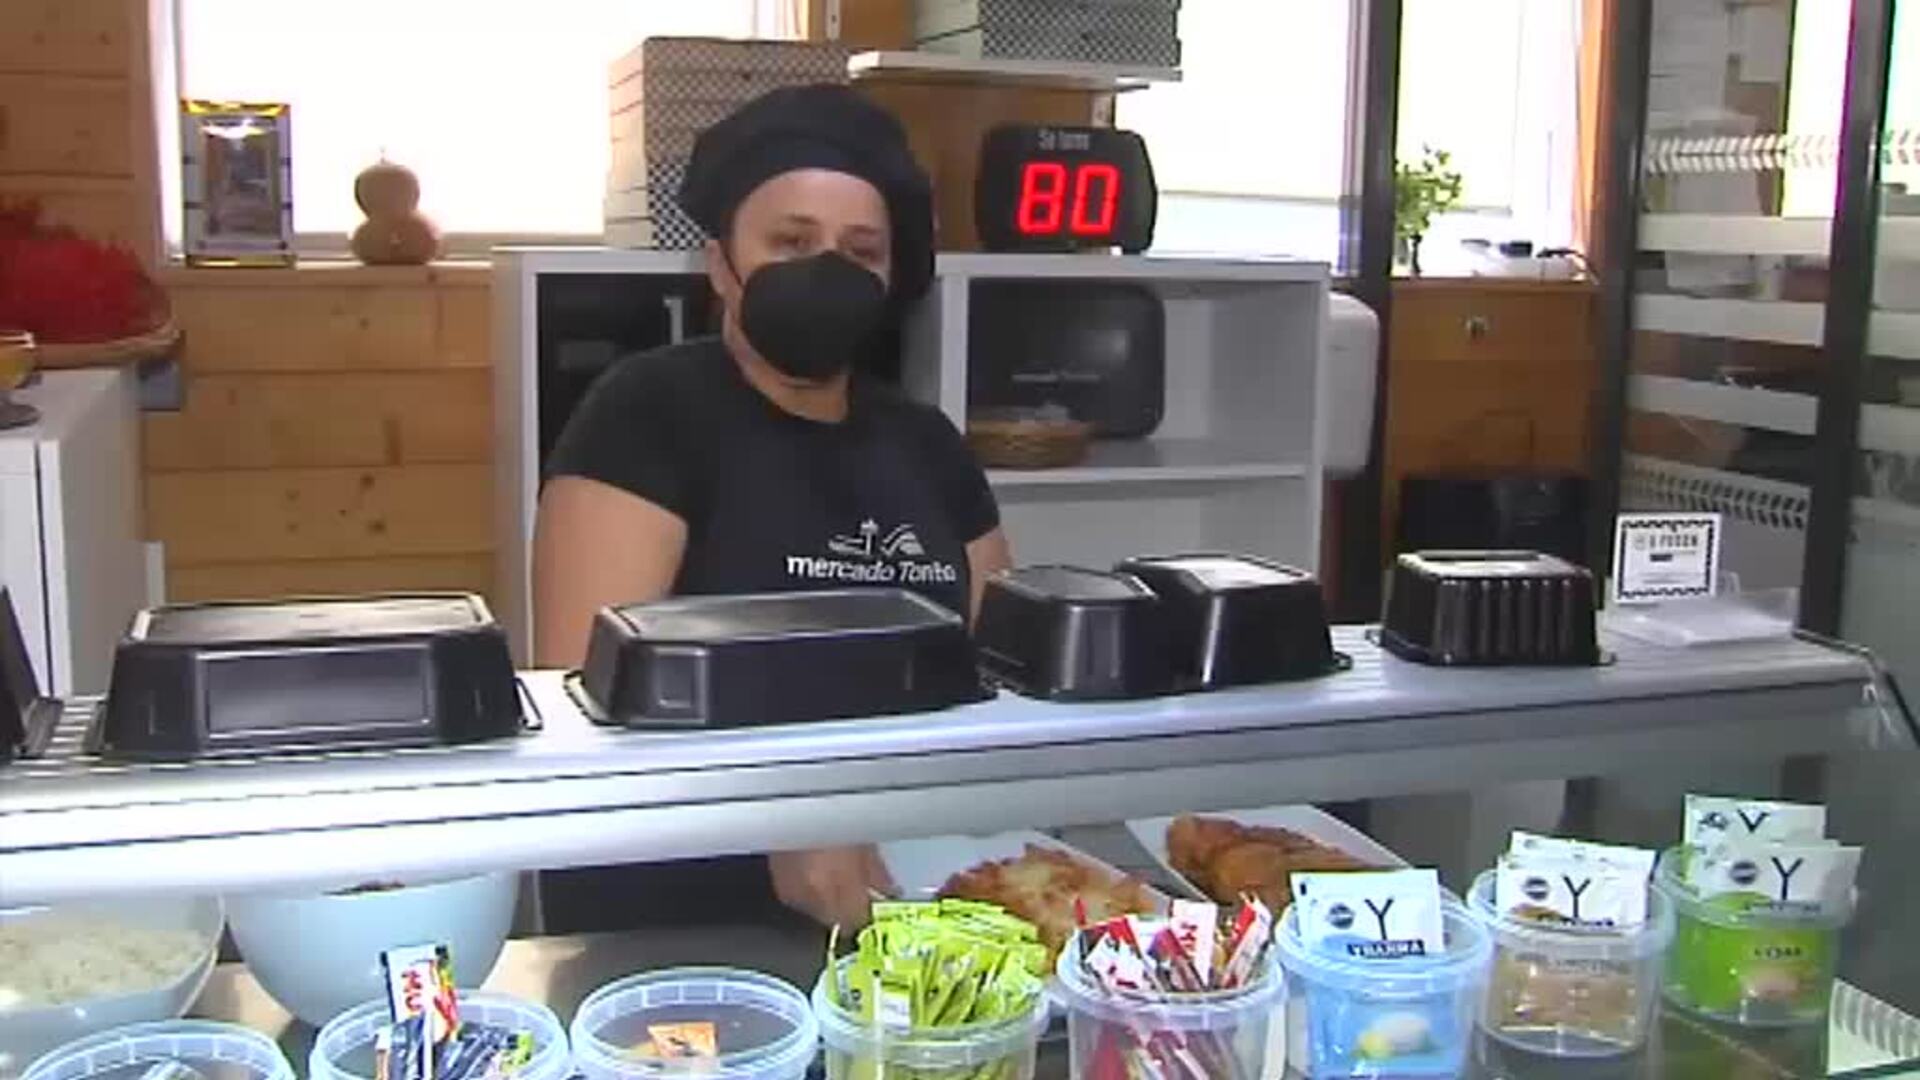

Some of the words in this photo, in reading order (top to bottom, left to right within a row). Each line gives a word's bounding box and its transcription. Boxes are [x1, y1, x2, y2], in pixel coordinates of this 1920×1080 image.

[1019, 163, 1119, 234] 80
[786, 555, 896, 582] mercado
[1561, 874, 1591, 918] Y
[1771, 856, 1804, 900] Y
[1363, 897, 1395, 941] Y
